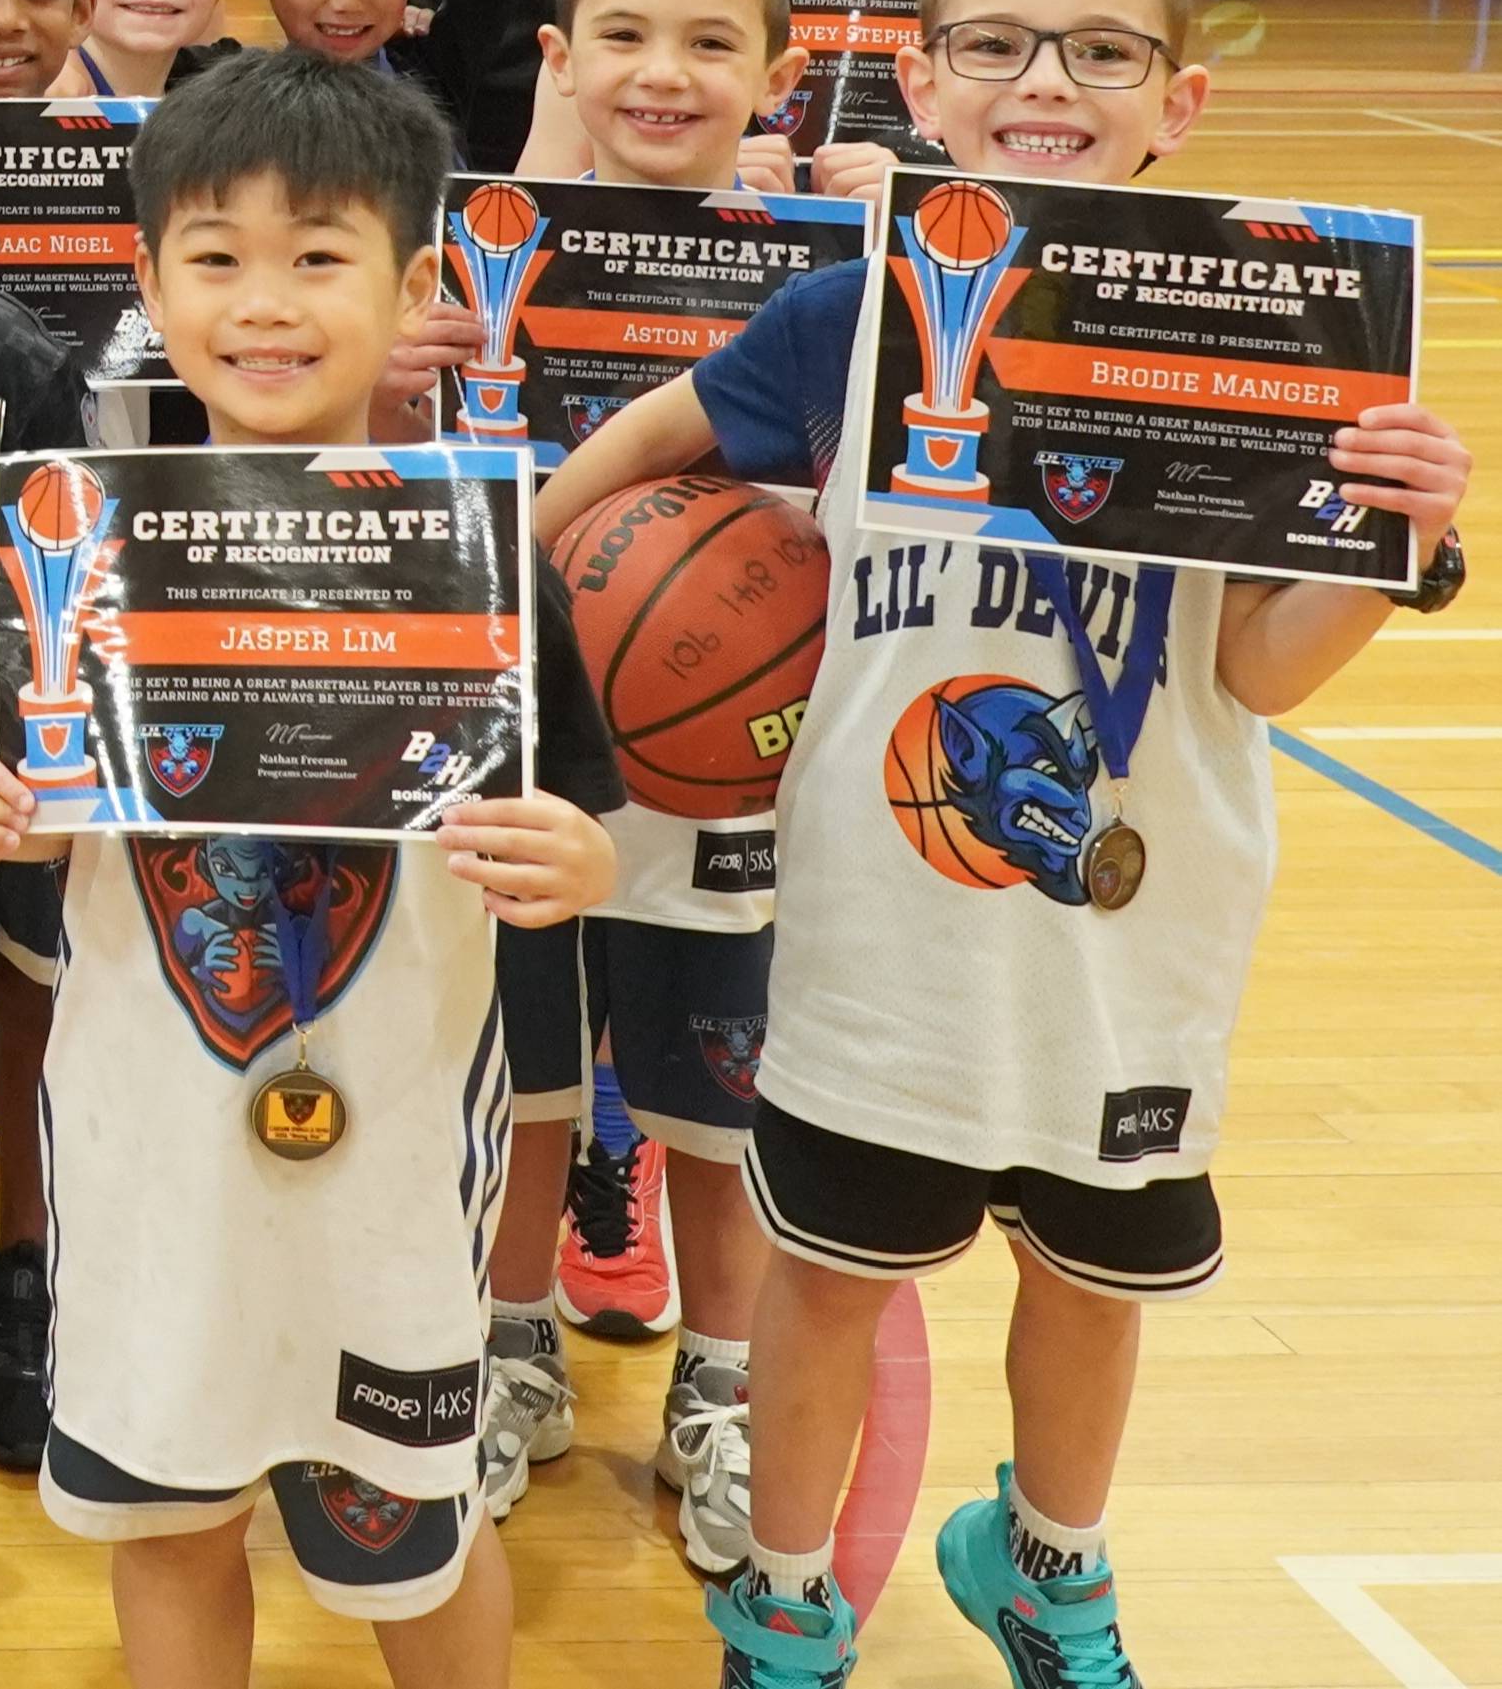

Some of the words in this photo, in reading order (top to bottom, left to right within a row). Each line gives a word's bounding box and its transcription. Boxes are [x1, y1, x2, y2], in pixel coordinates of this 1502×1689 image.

[787, 22, 841, 41] RVEY
[846, 24, 923, 45] STEPHE
[46, 235, 113, 253] NIGEL
[562, 228, 809, 270] CERTIFICATE
[605, 259, 628, 273] OF
[635, 261, 765, 284] RECOGNITION
[1042, 241, 1362, 301] CERTIFICATE
[1097, 281, 1128, 300] OF
[1136, 285, 1304, 318] RECOGNITION
[623, 322, 698, 347] ASTON
[1073, 320, 1105, 334] THIS
[1110, 325, 1196, 343] CERTIFICATE
[1202, 334, 1214, 345] IS
[1220, 335, 1300, 353] PRESENTED
[1305, 342, 1322, 355] TO
[1092, 361, 1199, 394] BRODIE
[1212, 372, 1339, 408] MANGER
[1047, 406, 1070, 418] KEY
[1075, 408, 1090, 419] TO
[1095, 410, 1133, 424] BEING
[1137, 414, 1146, 425] A
[1150, 416, 1189, 430] GREAT
[1194, 420, 1272, 438] BASKETBALL
[1277, 429, 1323, 443] PLAYER
[134, 510, 448, 541] CERTIFICATE
[188, 546, 217, 562] OF
[225, 546, 392, 564] RECOGNITION
[167, 588, 197, 598] THIS
[202, 588, 286, 599] CERTIFICATE
[292, 589, 305, 599] IS
[310, 589, 391, 600] PRESENTED
[395, 589, 413, 600] TO
[971, 550, 1135, 660] DEVI
[219, 625, 329, 653] JASPER
[340, 627, 397, 653] LIM
[662, 629, 722, 680] 106
[259, 754, 297, 764] Nathan
[300, 755, 347, 766] Freeman
[399, 730, 473, 785] B2H
[749, 849, 772, 872] 5XS
[1140, 1107, 1176, 1132] 4XS
[433, 1386, 472, 1421] 4XS
[1019, 1541, 1083, 1584] NBA
